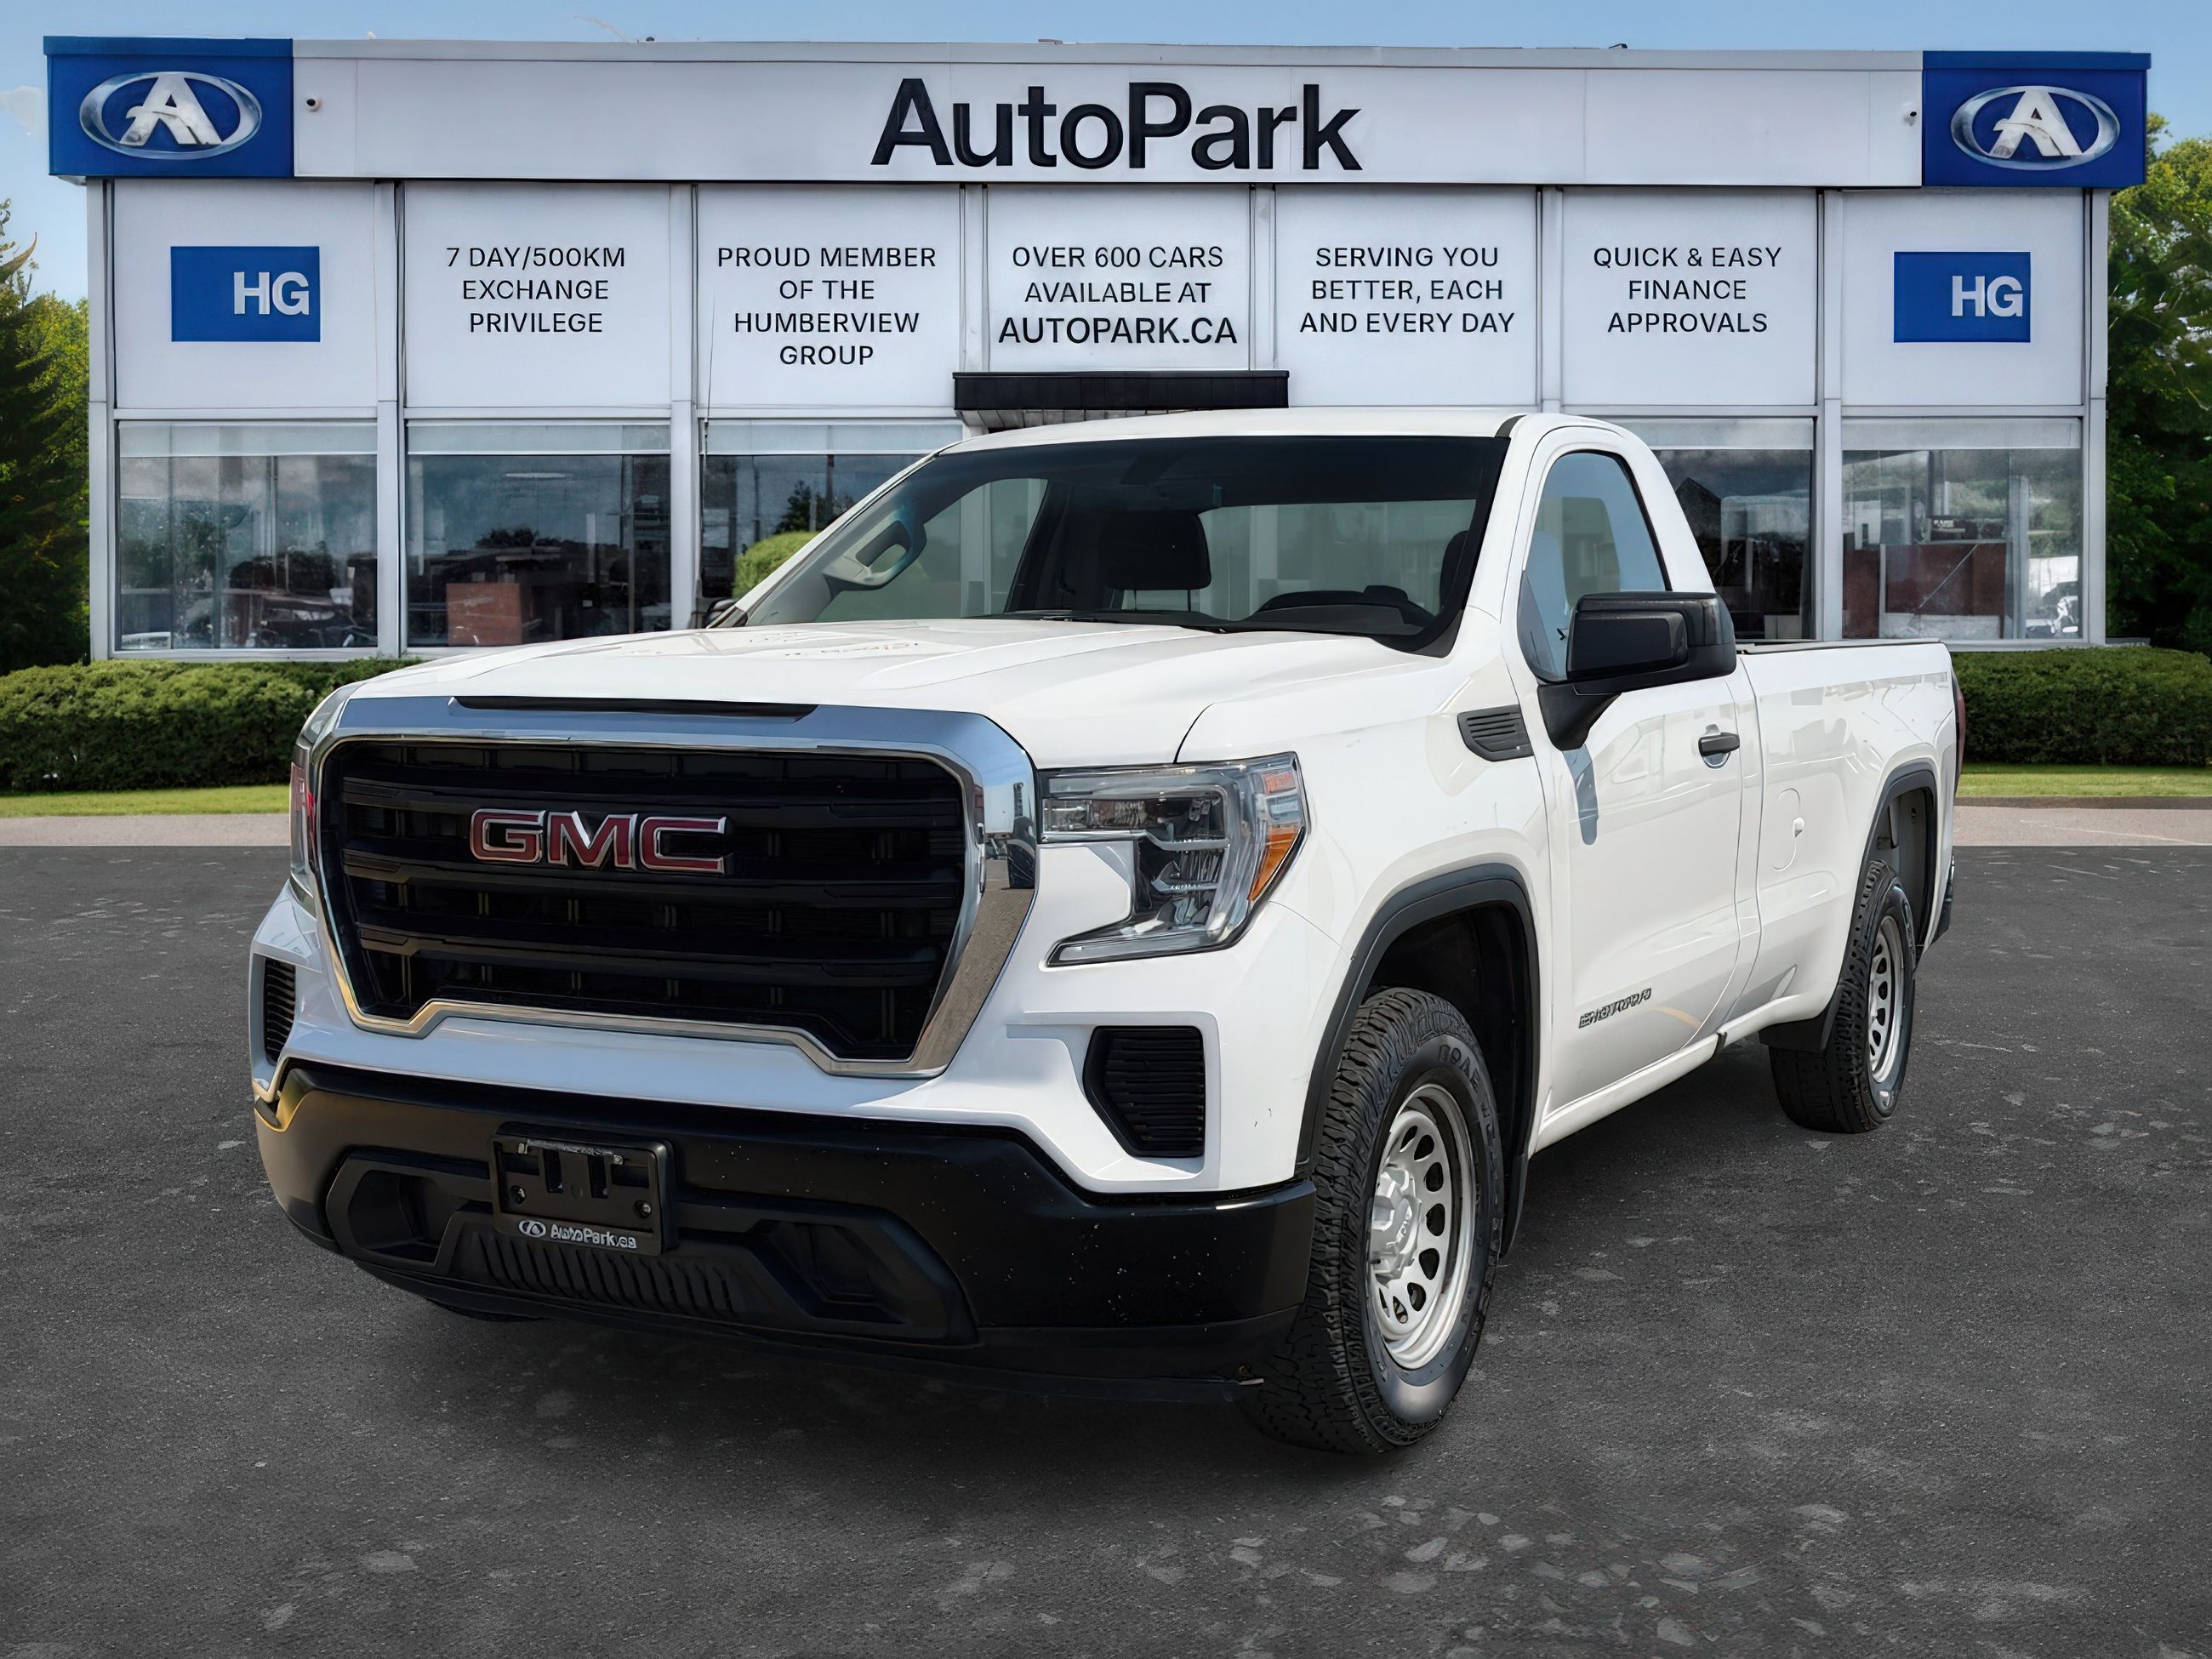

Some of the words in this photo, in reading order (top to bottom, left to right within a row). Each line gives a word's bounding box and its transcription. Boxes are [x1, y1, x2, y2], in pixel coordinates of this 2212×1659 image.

[869, 77, 1363, 171] AutoPark
[446, 247, 460, 268] 7
[470, 247, 625, 271] DAY/500KM
[717, 247, 810, 267] PROUD
[820, 247, 937, 267] MEMBER
[1012, 246, 1086, 268] OVER
[1095, 247, 1141, 268] 600
[1149, 246, 1223, 268] CARS
[1315, 247, 1434, 267] SERVING
[1442, 247, 1499, 267] YOU
[1593, 247, 1679, 270] QUICK
[1687, 247, 1703, 268] &
[1712, 247, 1782, 267] EASY
[232, 271, 311, 316] HG
[462, 279, 609, 300] EXCHANGE
[778, 280, 813, 299] OF
[821, 280, 875, 299] THE
[1024, 282, 1172, 304] AVAILABLE
[1177, 282, 1212, 303] AT
[1311, 279, 1421, 305] BETTER,
[1430, 279, 1503, 300] EACH
[1628, 279, 1747, 300] FINANCE
[1951, 275, 2024, 318] HG
[470, 312, 603, 333] PRIVILEGE
[734, 312, 920, 333] HUMBERVIEW
[998, 316, 1238, 345] AUTOPARK.CA
[1299, 312, 1358, 333] AND
[1365, 312, 1454, 333] EVERY
[1462, 312, 1516, 333] DAY
[1606, 312, 1769, 333] APPROVALS
[779, 345, 875, 366] GROUP
[470, 808, 727, 875] GMC
